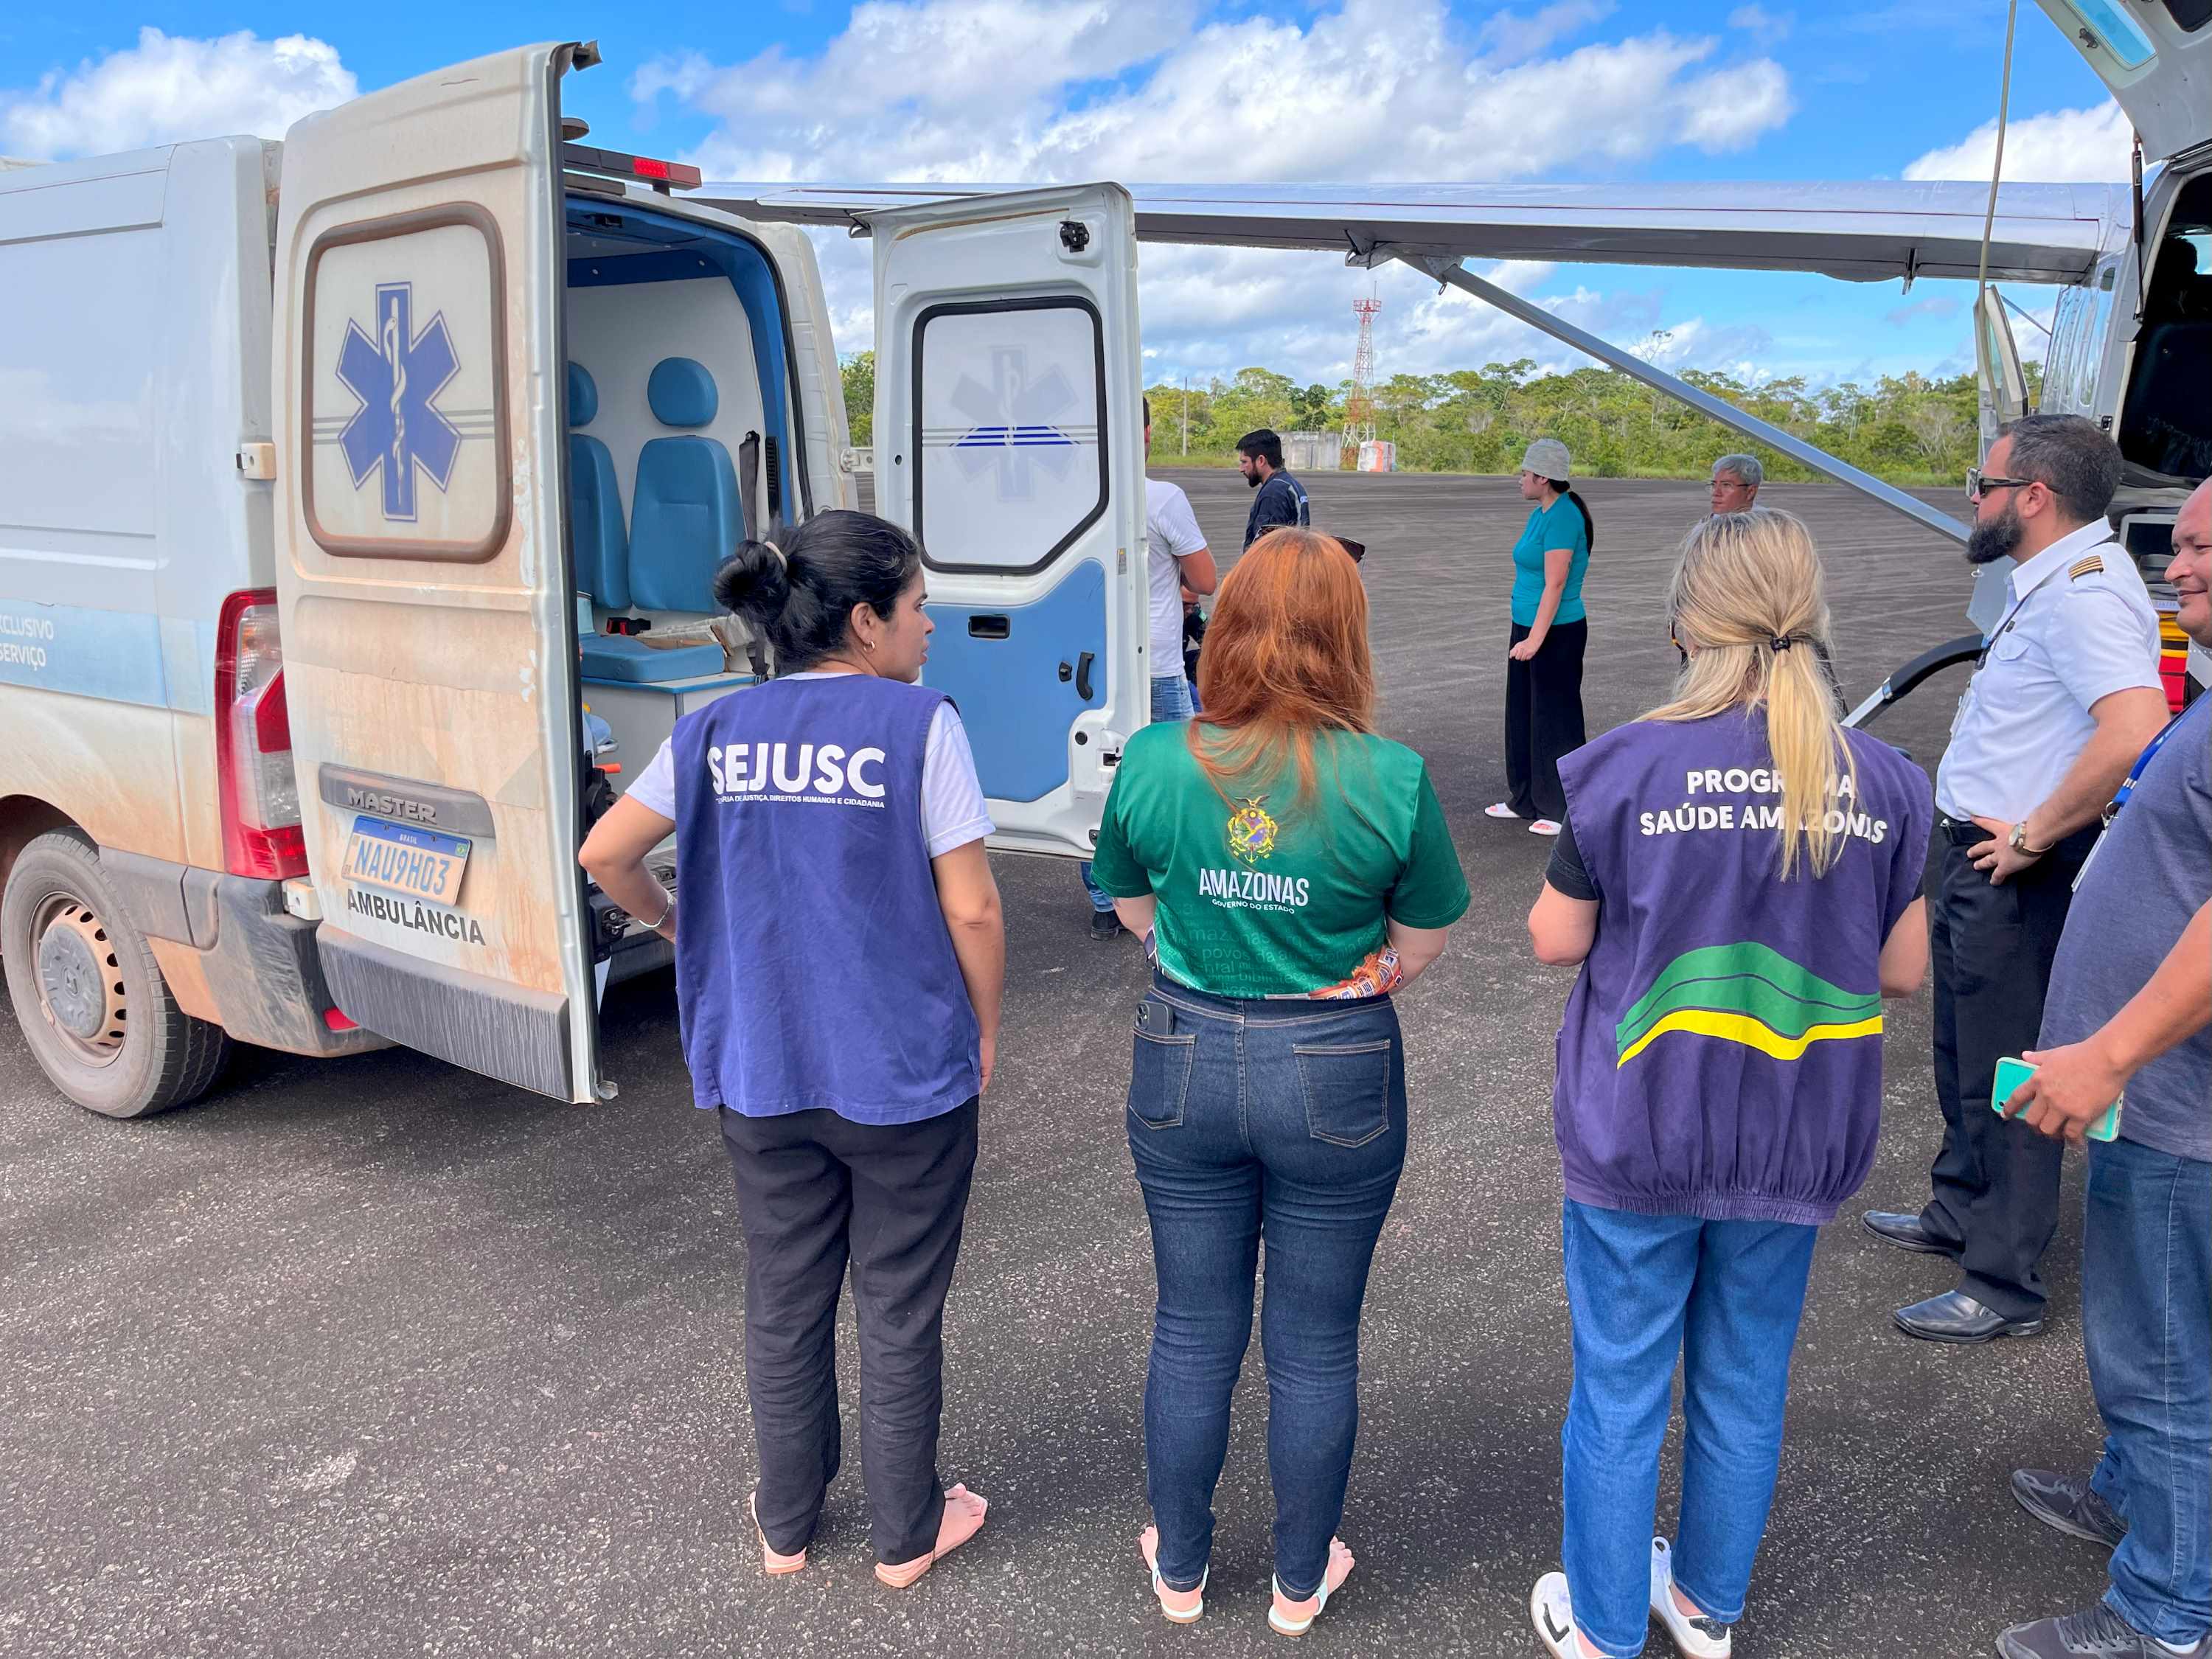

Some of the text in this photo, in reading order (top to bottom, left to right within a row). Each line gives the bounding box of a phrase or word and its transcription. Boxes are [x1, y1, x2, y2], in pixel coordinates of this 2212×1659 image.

[708, 743, 885, 797] SEJUSC
[1687, 768, 1856, 799] PROGRA
[348, 788, 437, 824] MASTER
[770, 795, 801, 803] DIREITOS
[803, 796, 836, 804] HUMANOS
[844, 798, 886, 809] CIDADANIA
[1640, 802, 1734, 836] SAÚDE
[399, 833, 417, 844] BRASIL
[353, 839, 450, 895] NAU9H03
[1199, 868, 1310, 907] AMAZONAS
[347, 888, 486, 946] AMBULÂNCIA
[1211, 899, 1295, 915] GOVERNO DO ESTADO
[1203, 948, 1251, 962] povos
